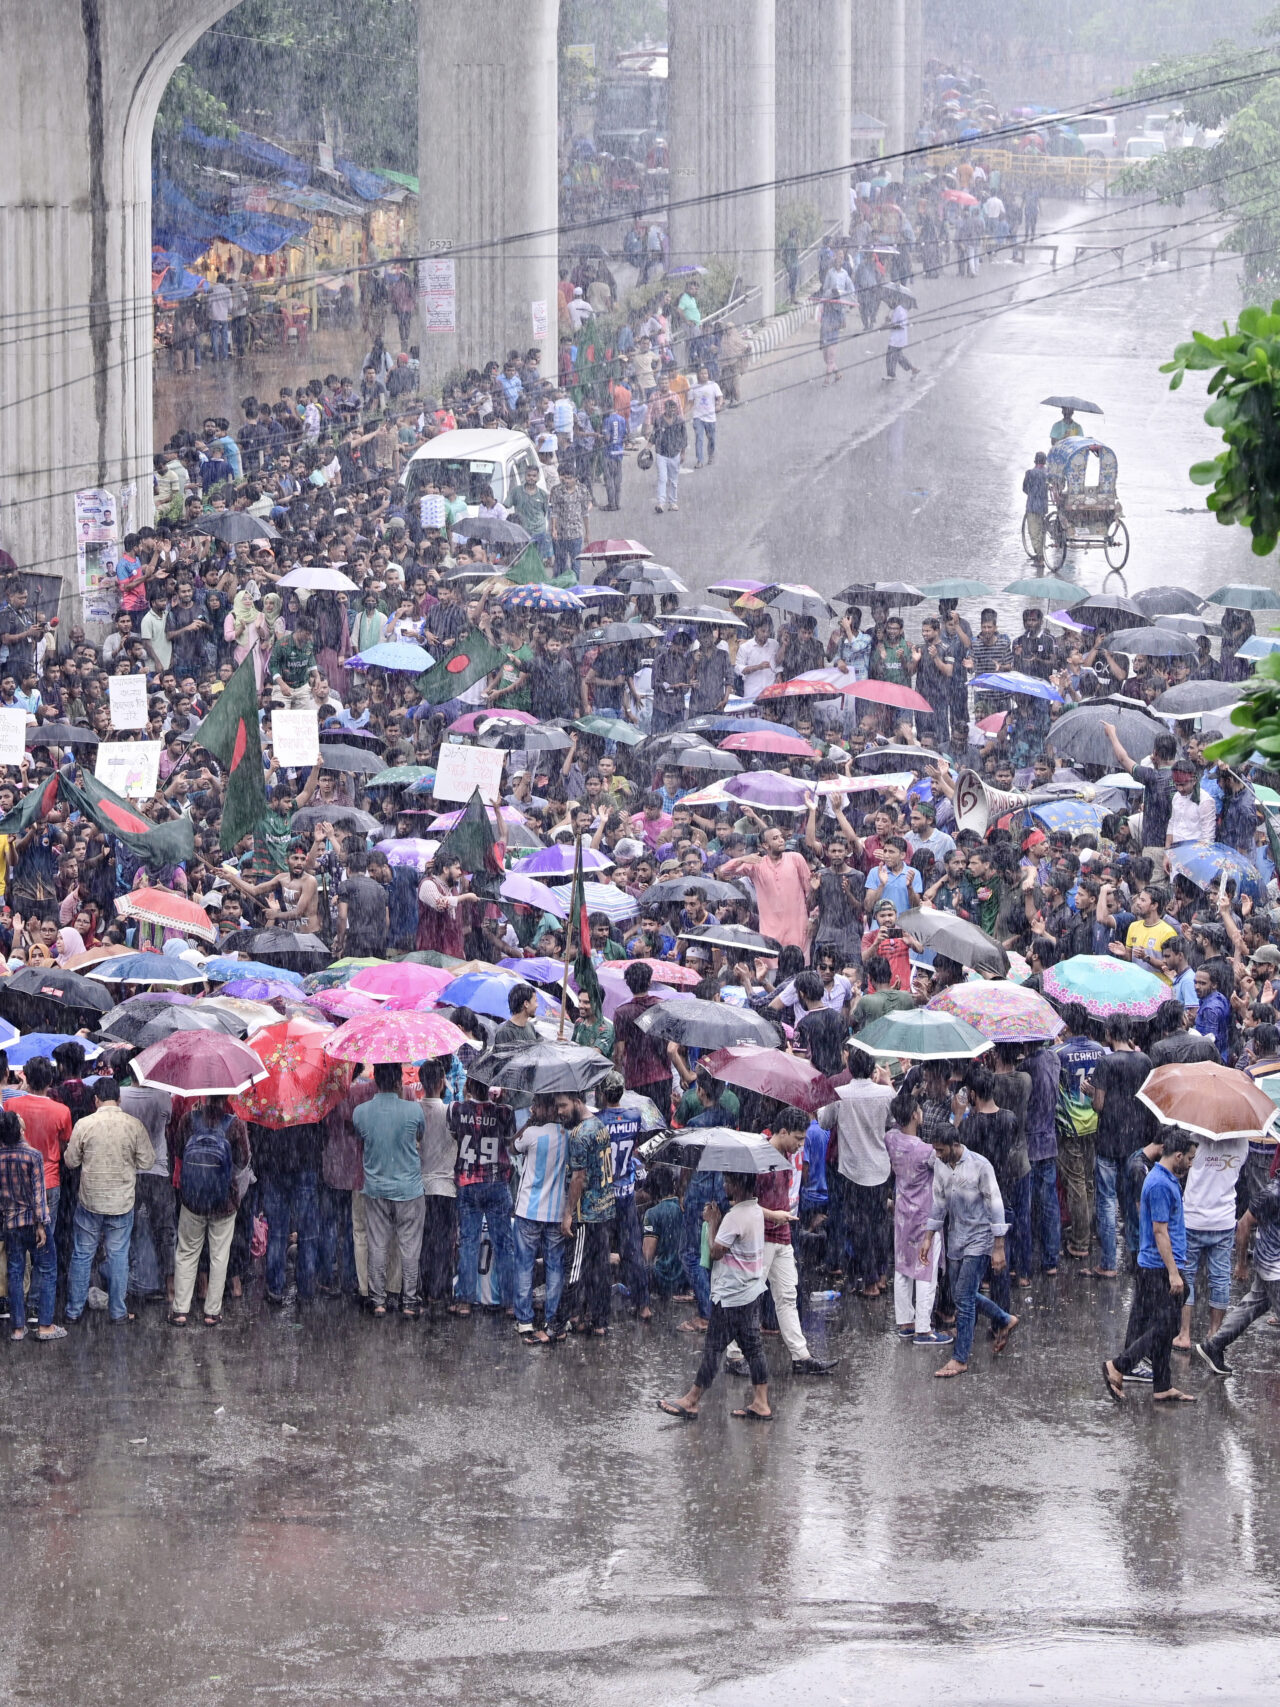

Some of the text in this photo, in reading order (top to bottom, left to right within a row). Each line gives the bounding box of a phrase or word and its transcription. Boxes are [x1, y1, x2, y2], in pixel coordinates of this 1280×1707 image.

[430, 241, 452, 249] P523
[460, 1114, 498, 1127] MASUD
[460, 1135, 499, 1165] 49
